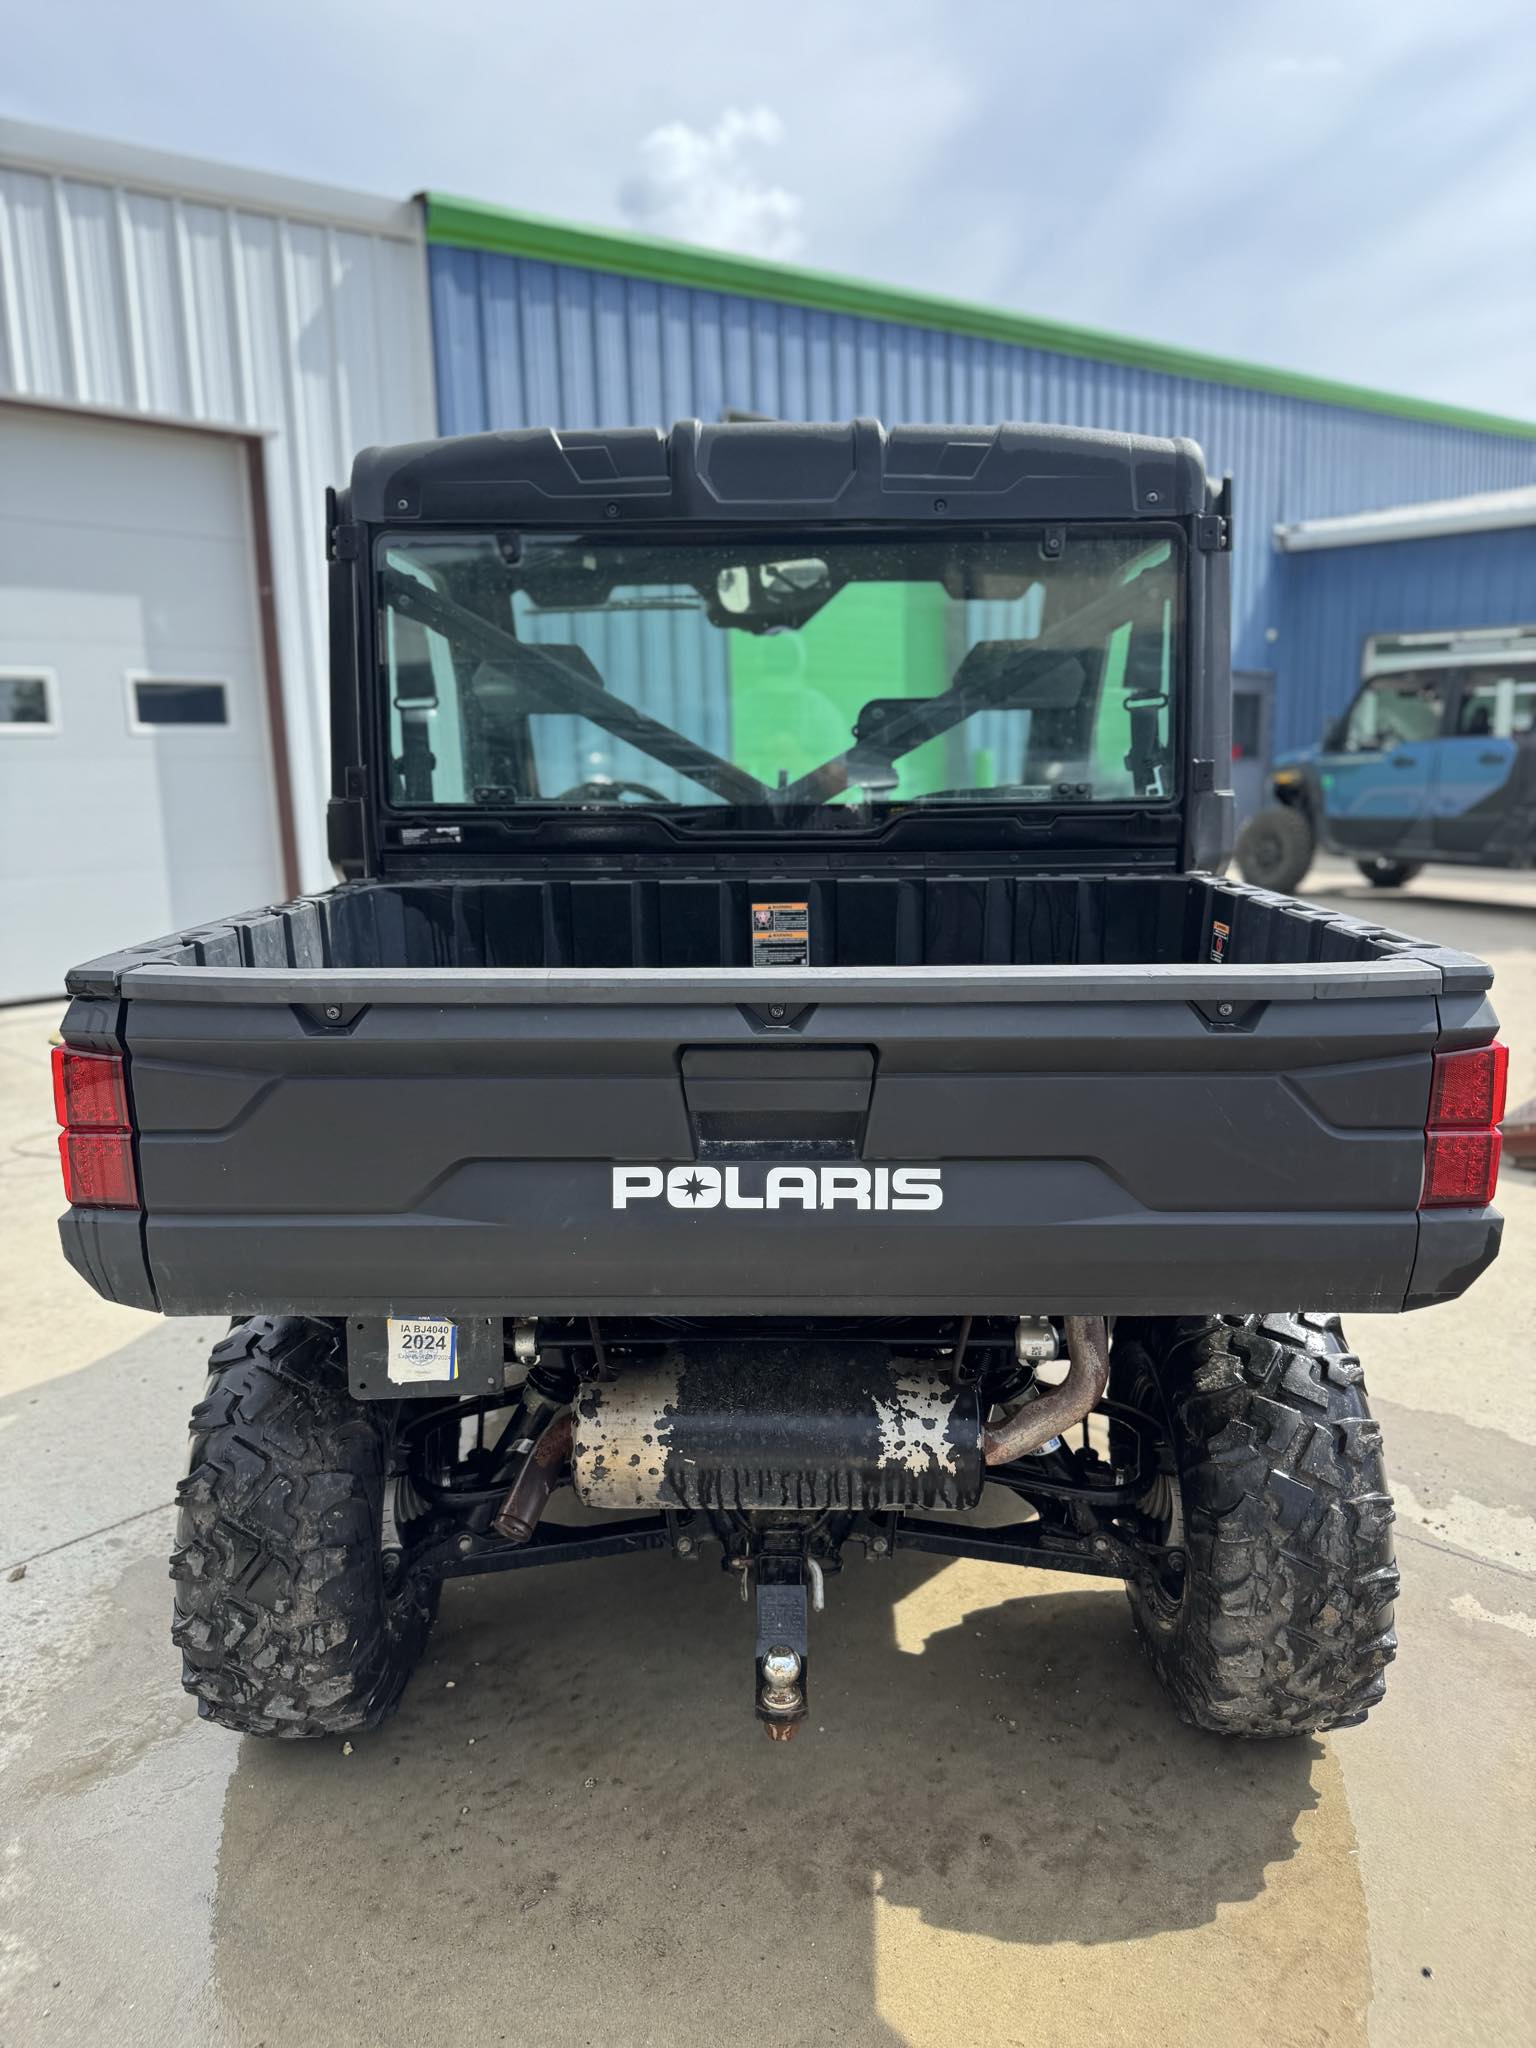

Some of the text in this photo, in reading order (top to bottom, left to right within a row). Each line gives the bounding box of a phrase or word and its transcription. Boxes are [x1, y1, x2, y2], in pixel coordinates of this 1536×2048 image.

[612, 1166, 944, 1211] POLARIS
[400, 1324, 449, 1334] IA BJ4040
[401, 1334, 447, 1350] 2024
